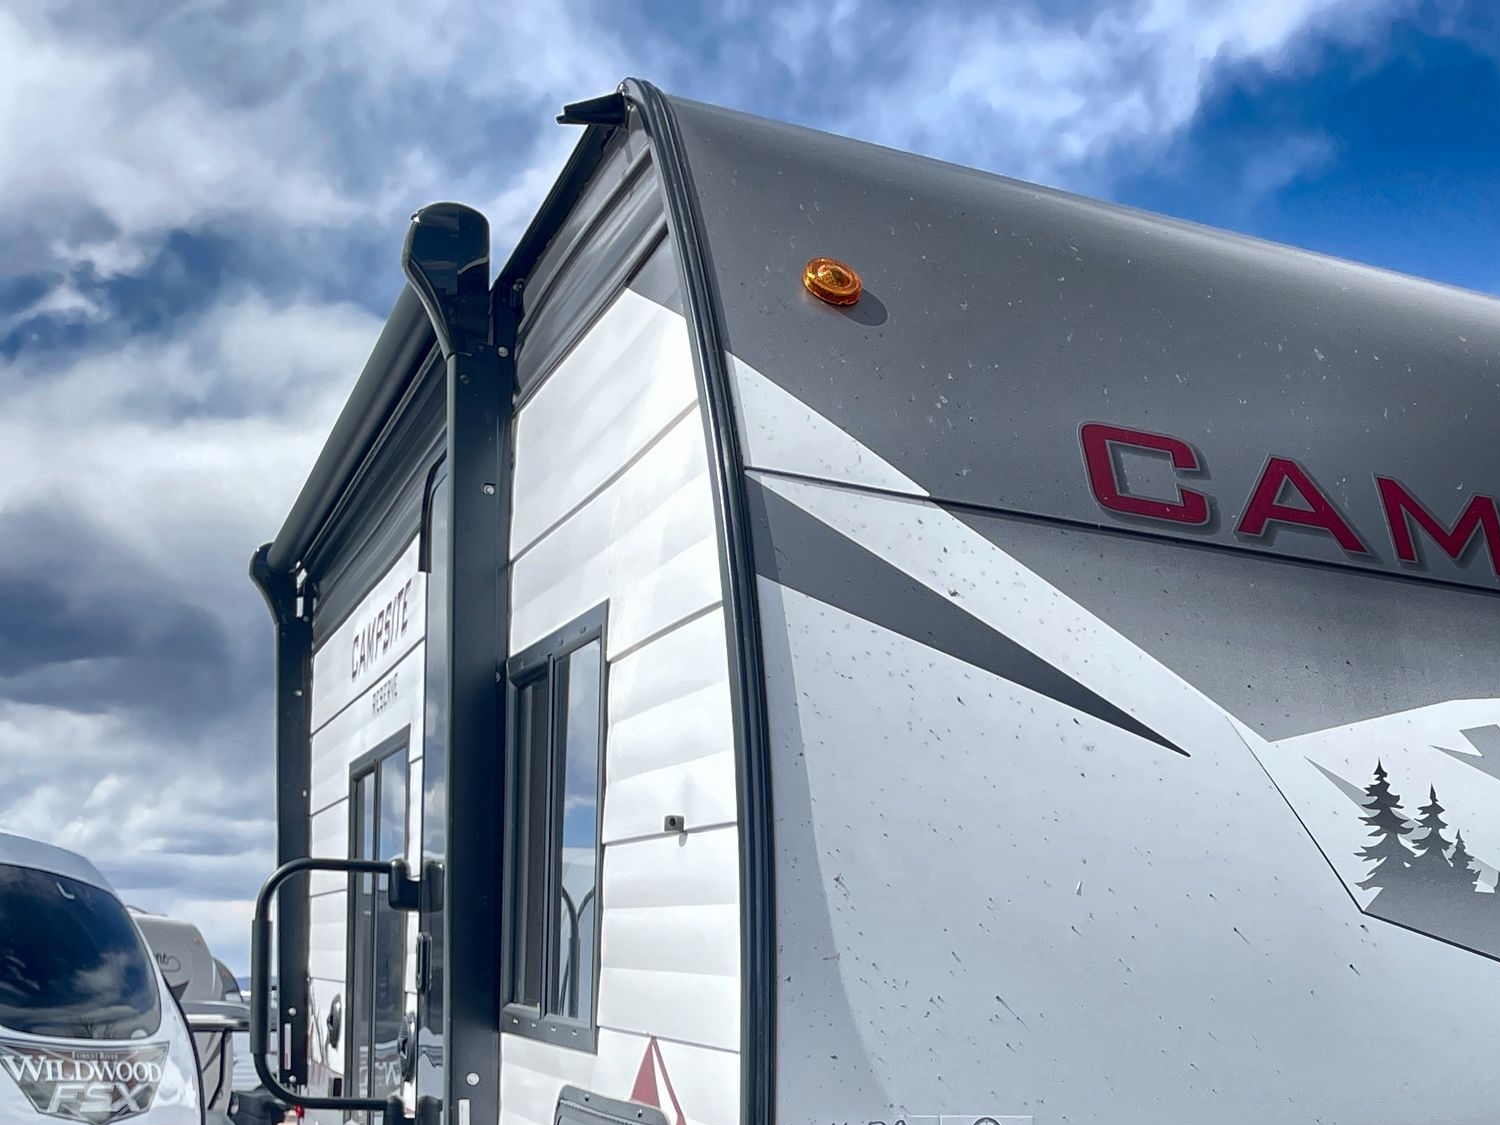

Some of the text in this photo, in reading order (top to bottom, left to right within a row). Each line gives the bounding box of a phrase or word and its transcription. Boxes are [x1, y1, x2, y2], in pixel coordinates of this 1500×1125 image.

[351, 579, 412, 683] CAMPSITE
[2, 1055, 162, 1082] WILDWOOD
[47, 1082, 149, 1113] FSX
